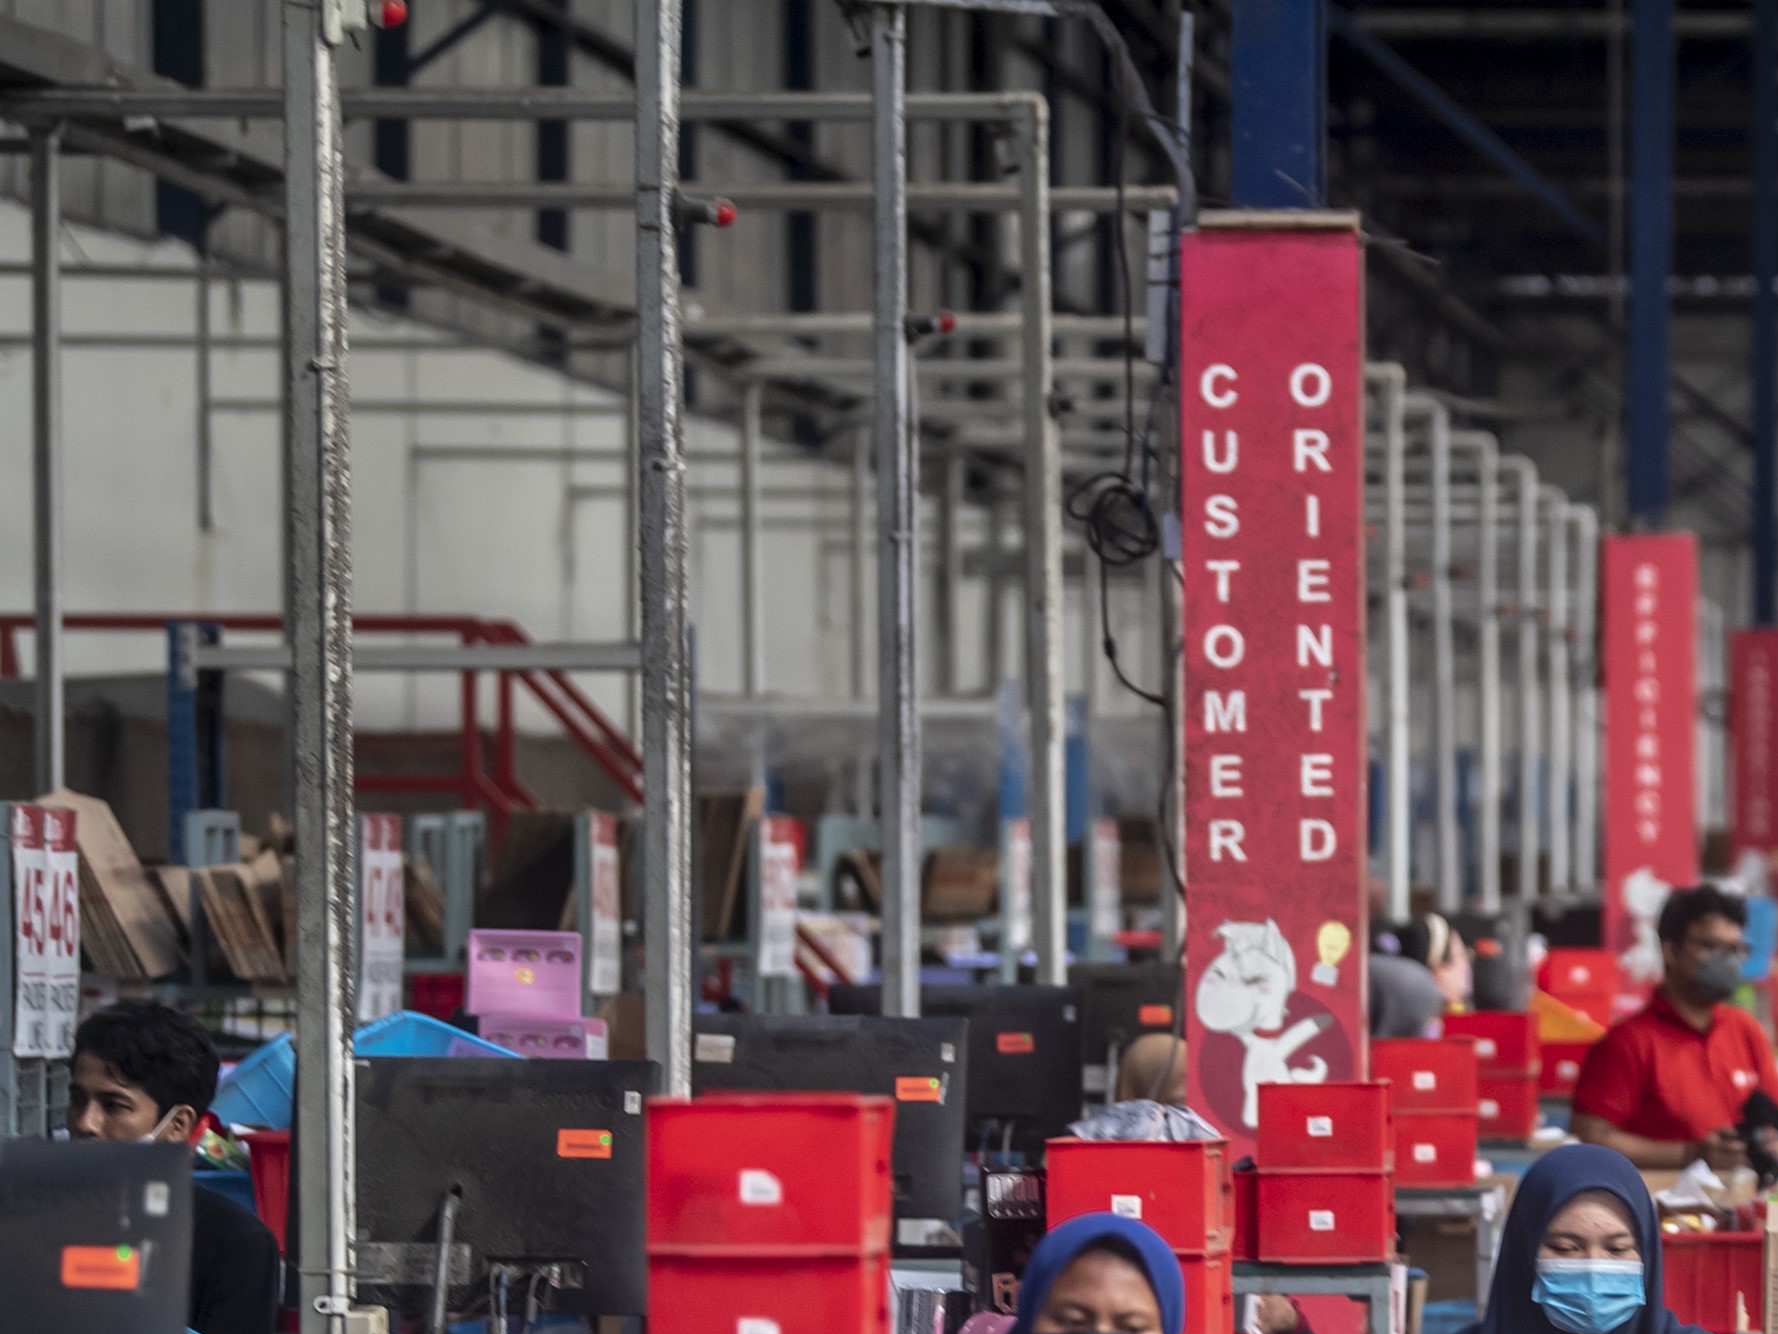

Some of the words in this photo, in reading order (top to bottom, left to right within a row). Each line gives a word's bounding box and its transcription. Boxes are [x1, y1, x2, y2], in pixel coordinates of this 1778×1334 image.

[1200, 363, 1248, 863] CUSTOMER
[1289, 363, 1337, 862] ORIENTED
[21, 866, 45, 957] 45
[50, 869, 77, 958] 46
